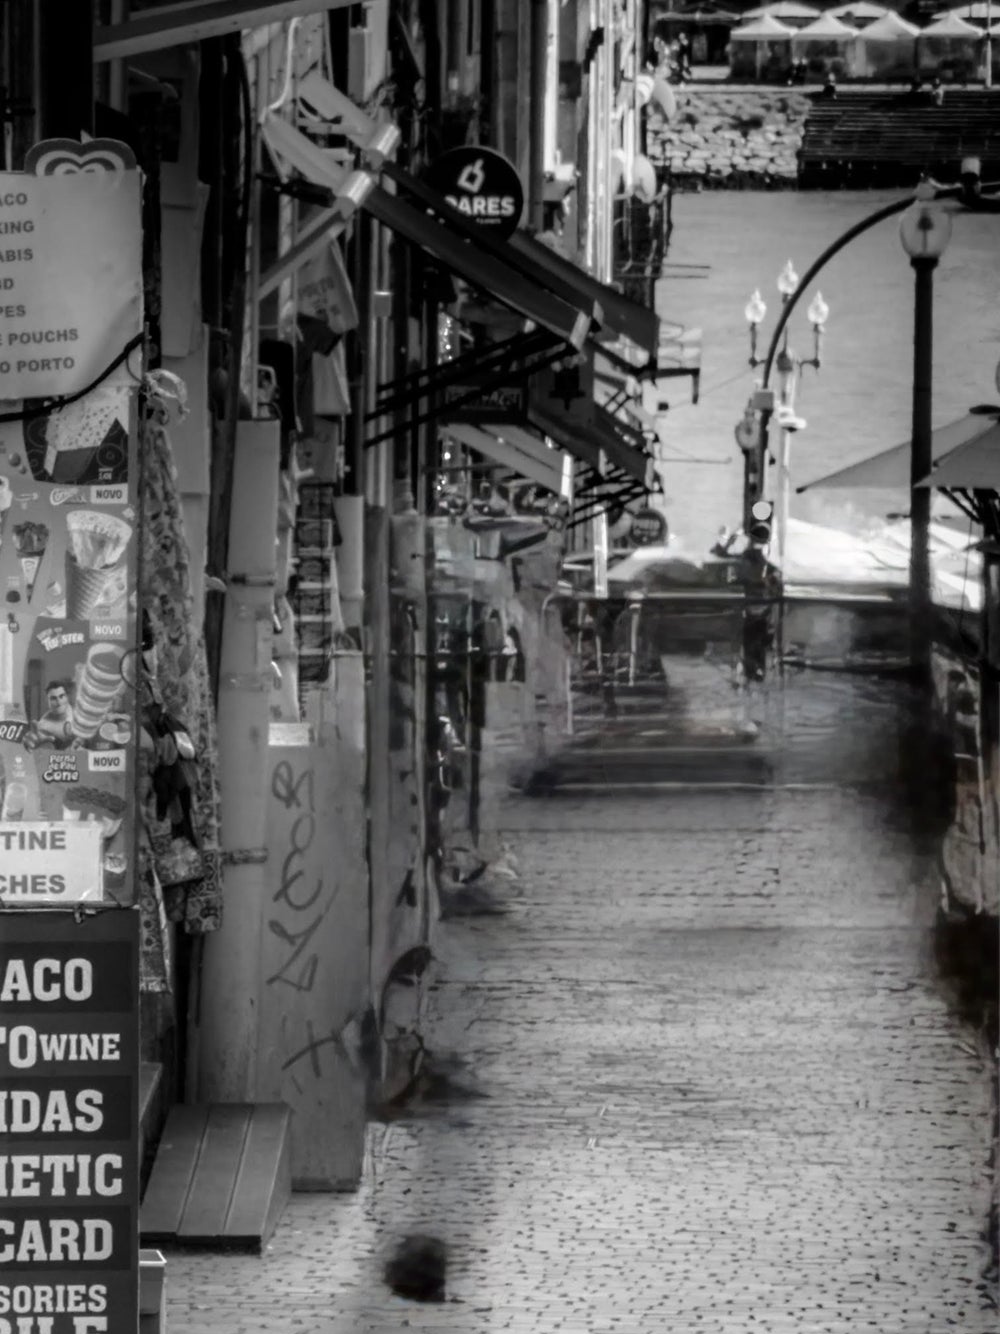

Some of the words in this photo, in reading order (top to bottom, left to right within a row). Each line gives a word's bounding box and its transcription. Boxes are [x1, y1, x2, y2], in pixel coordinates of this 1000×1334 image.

[8, 328, 79, 346] POUCHS
[17, 357, 75, 373] PORTO
[96, 489, 123, 499] NOVO
[94, 624, 122, 635] NOVO
[93, 757, 121, 767] NOVO
[43, 769, 80, 782] Cone
[39, 1032, 121, 1063] WINE
